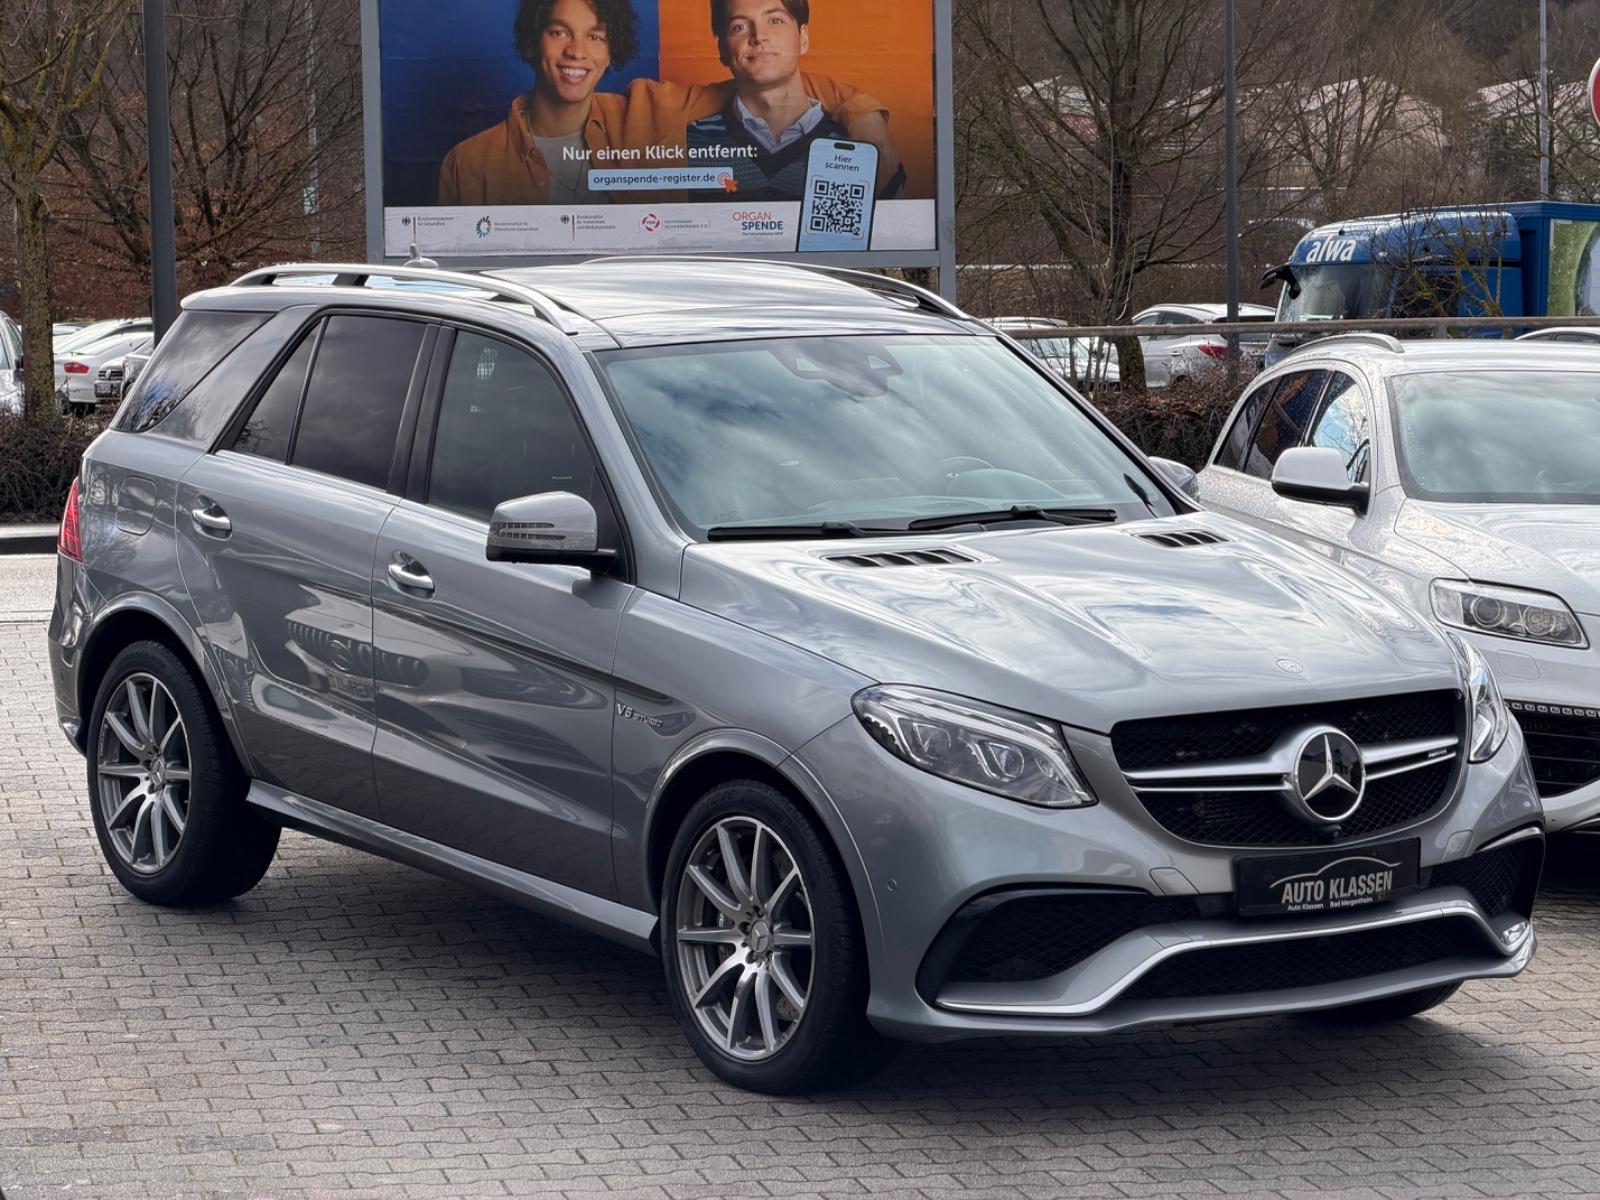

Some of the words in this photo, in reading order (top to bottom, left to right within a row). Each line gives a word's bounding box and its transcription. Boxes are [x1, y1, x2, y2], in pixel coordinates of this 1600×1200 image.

[562, 146, 592, 160] Nur
[596, 146, 641, 160] einen
[645, 145, 684, 159] Klick
[688, 144, 758, 158] entfernt:
[834, 154, 853, 163] Hier
[825, 162, 860, 172] scannen
[593, 172, 716, 186] organspende-register.de
[732, 211, 772, 221] ORGAN
[741, 220, 784, 231] SPENDE
[1305, 233, 1357, 263] alwa
[1281, 879, 1325, 904] AUTO
[1329, 870, 1393, 899] KLASSEN
[1302, 902, 1324, 910] Klassen
[1329, 900, 1341, 908] Bad
